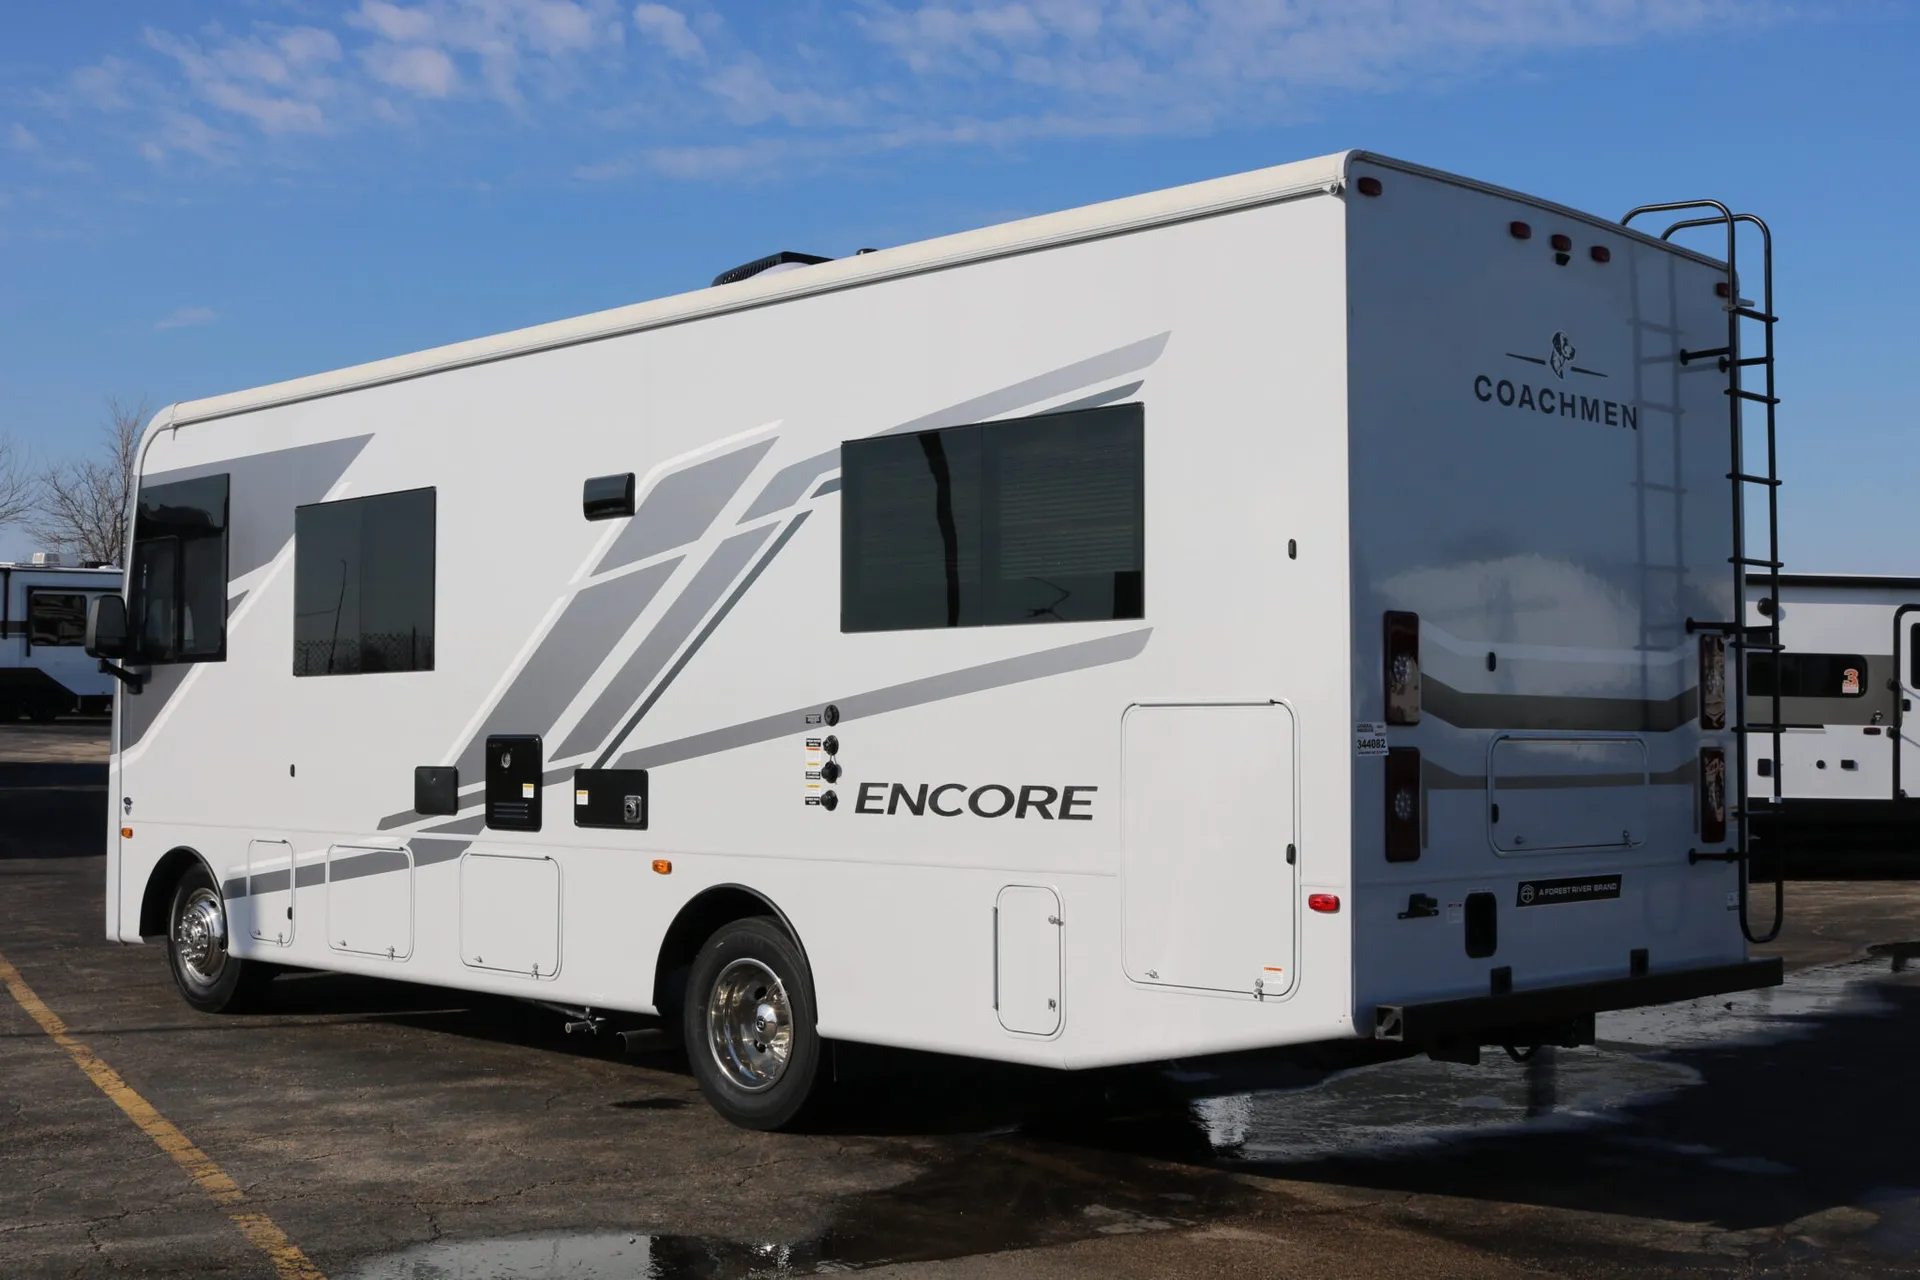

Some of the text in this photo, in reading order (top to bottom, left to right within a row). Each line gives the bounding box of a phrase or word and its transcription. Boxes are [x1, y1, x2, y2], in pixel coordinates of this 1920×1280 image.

[1474, 374, 1638, 431] COACHMEN
[1357, 738, 1386, 750] 344082
[854, 782, 1098, 821] ENCORE
[1545, 887, 1571, 896] FOREST
[1571, 885, 1592, 894] RIVER
[1594, 883, 1618, 891] BRAND
